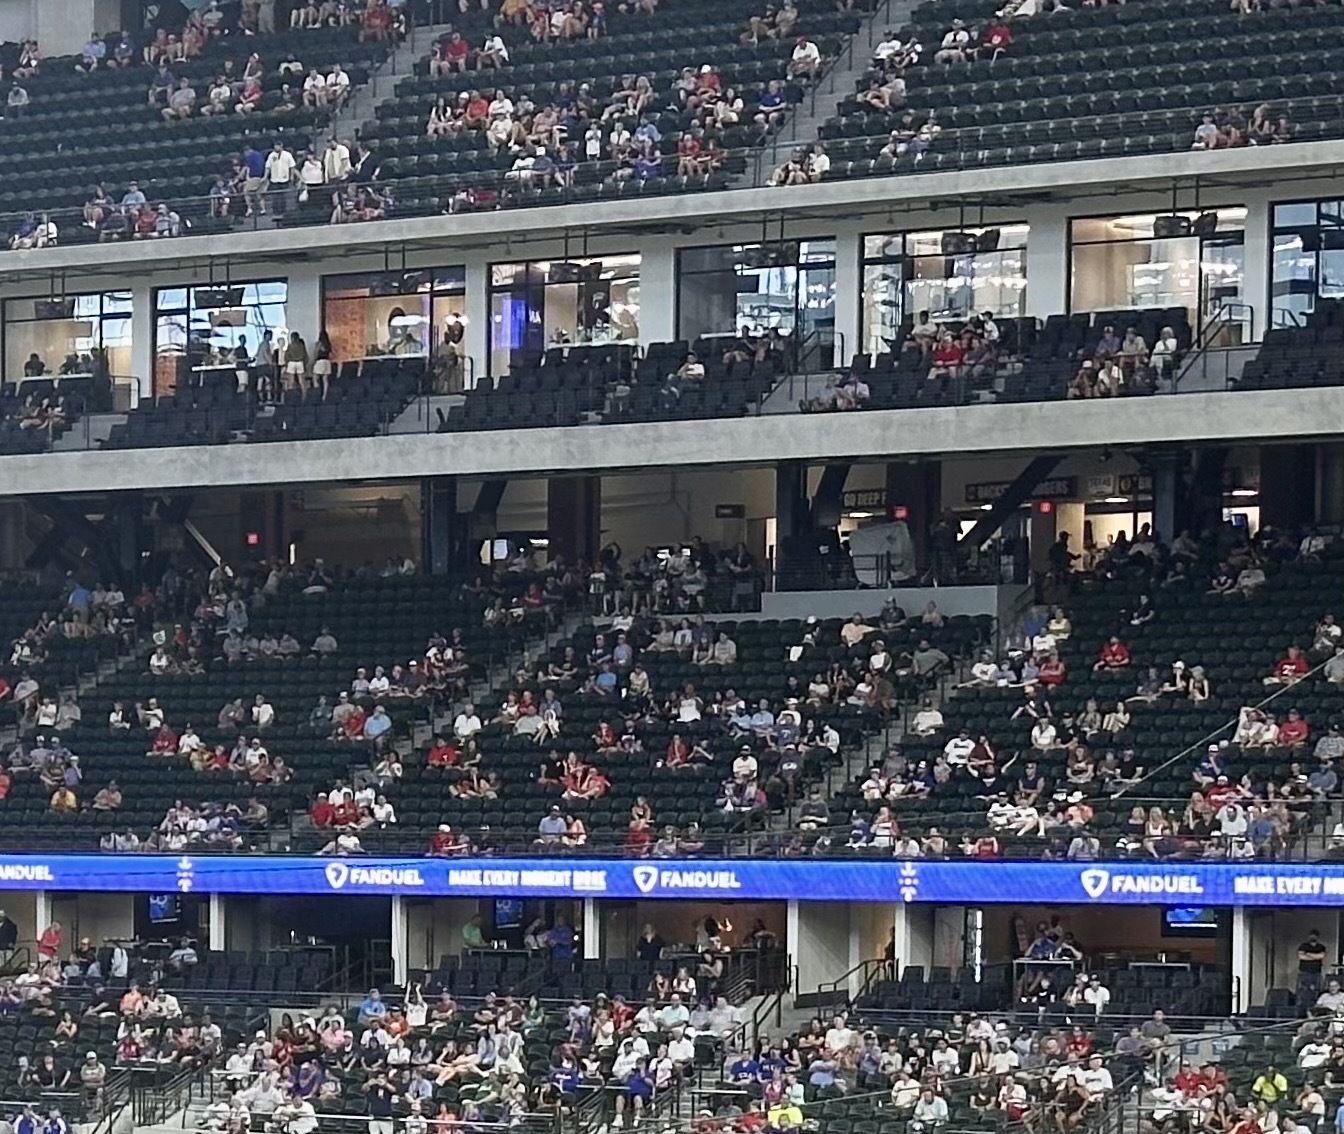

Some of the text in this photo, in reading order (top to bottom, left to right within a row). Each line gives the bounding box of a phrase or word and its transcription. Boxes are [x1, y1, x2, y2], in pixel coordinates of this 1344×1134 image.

[350, 869, 424, 885] FANDUEL
[449, 870, 482, 886] MAKE
[483, 870, 519, 886] EVERY
[660, 871, 741, 888] FANDUEL
[1112, 875, 1204, 894] FANDUEL
[1234, 876, 1275, 894] MAKE
[1277, 876, 1322, 894] EVERY
